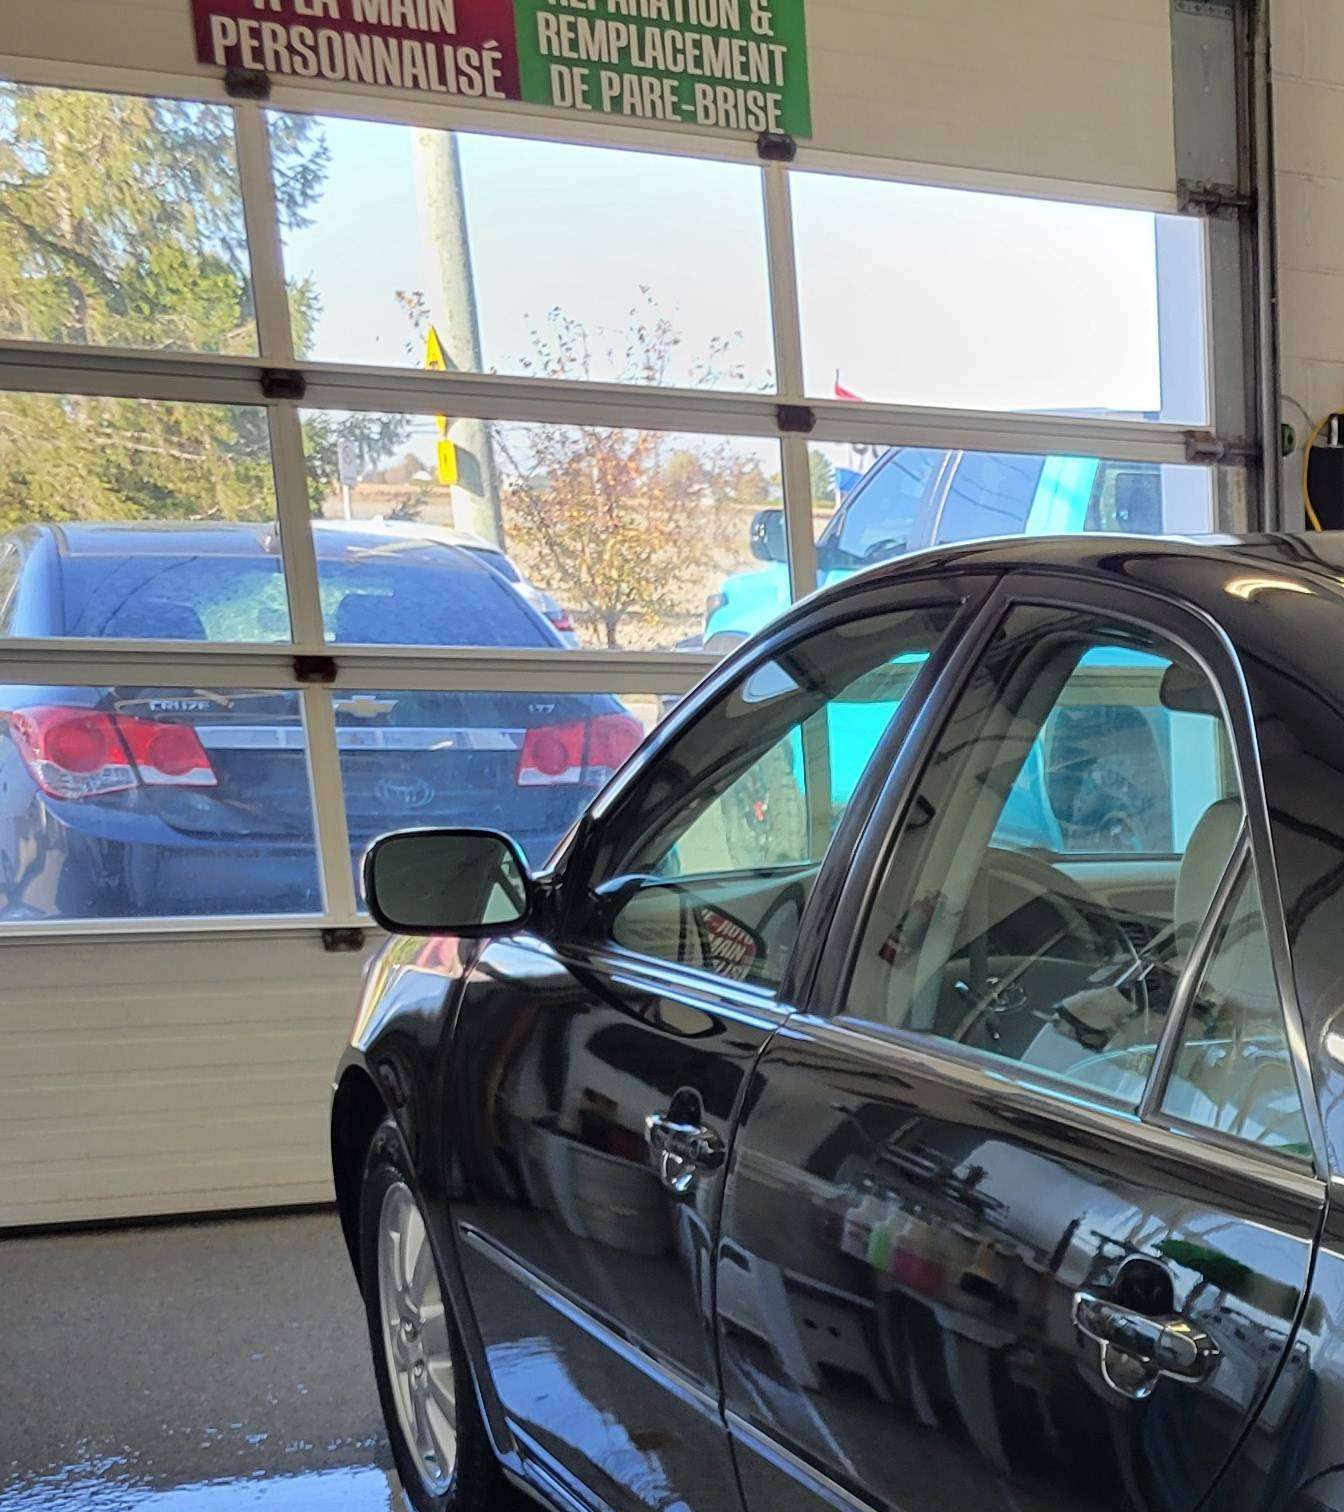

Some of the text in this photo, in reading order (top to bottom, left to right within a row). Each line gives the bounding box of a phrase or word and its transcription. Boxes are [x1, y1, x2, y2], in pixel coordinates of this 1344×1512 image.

[537, 11, 788, 86] REMPLACEMENT
[750, 0, 775, 36] &
[209, 14, 507, 99] PERSONNALISÉ
[550, 63, 785, 135] DE PARE-BRISE
